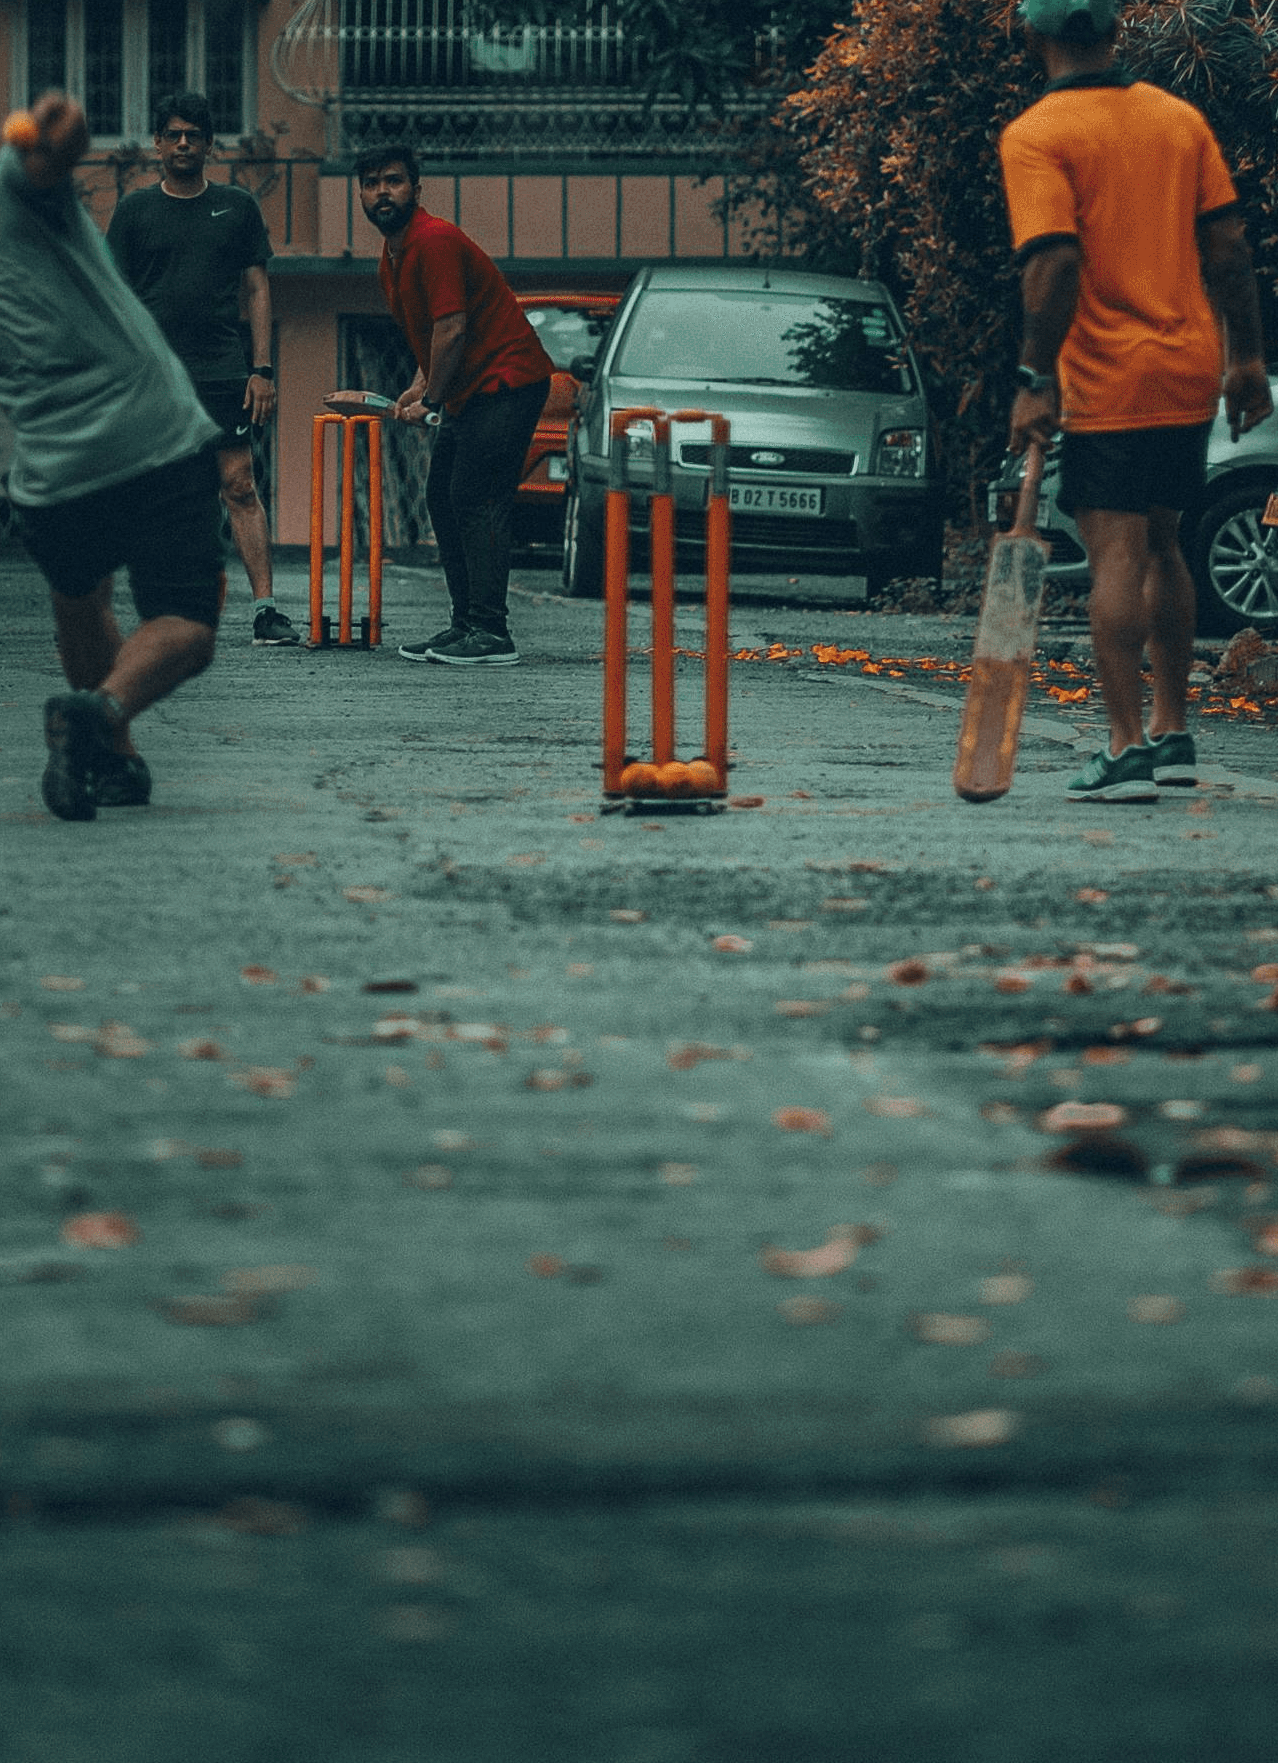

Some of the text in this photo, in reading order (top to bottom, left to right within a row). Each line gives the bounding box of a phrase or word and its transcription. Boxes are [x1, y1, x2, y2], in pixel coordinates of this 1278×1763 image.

[744, 489, 762, 506] 02
[767, 490, 775, 507] T
[779, 492, 816, 509] 5666
